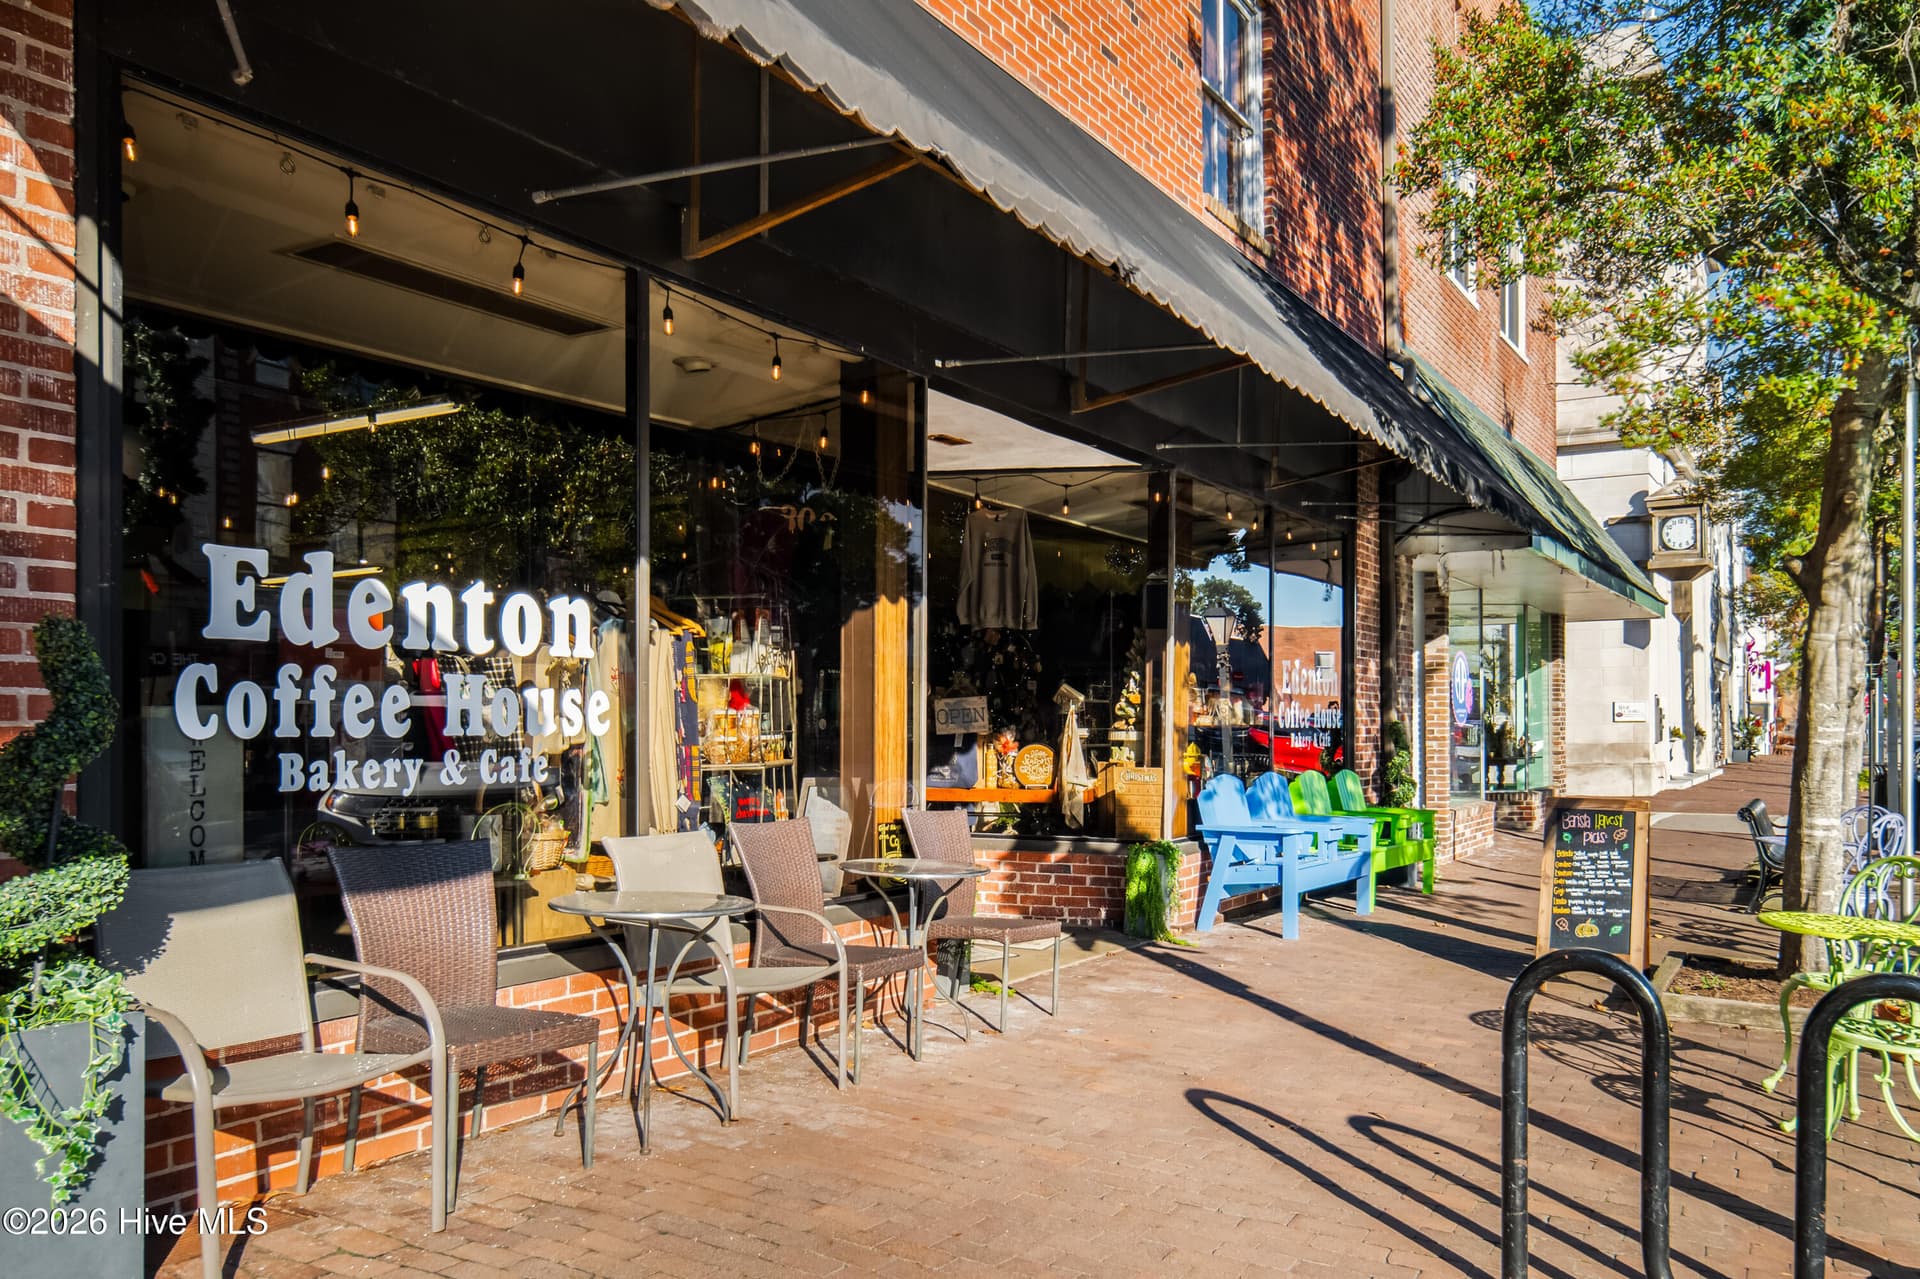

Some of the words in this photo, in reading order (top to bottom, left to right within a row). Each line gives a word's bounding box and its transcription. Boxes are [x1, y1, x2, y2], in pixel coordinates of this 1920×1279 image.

[202, 543, 594, 658] Edenton
[1282, 659, 1338, 697] Edenton
[175, 663, 412, 740] Coffee
[443, 672, 611, 737] House
[936, 707, 986, 725] OPEN
[1278, 701, 1311, 729] Coffee
[1314, 703, 1341, 729] House
[1290, 732, 1312, 751] Bakery
[278, 748, 424, 797] Bakery
[440, 749, 467, 785] &
[1562, 812, 1591, 830] Barista
